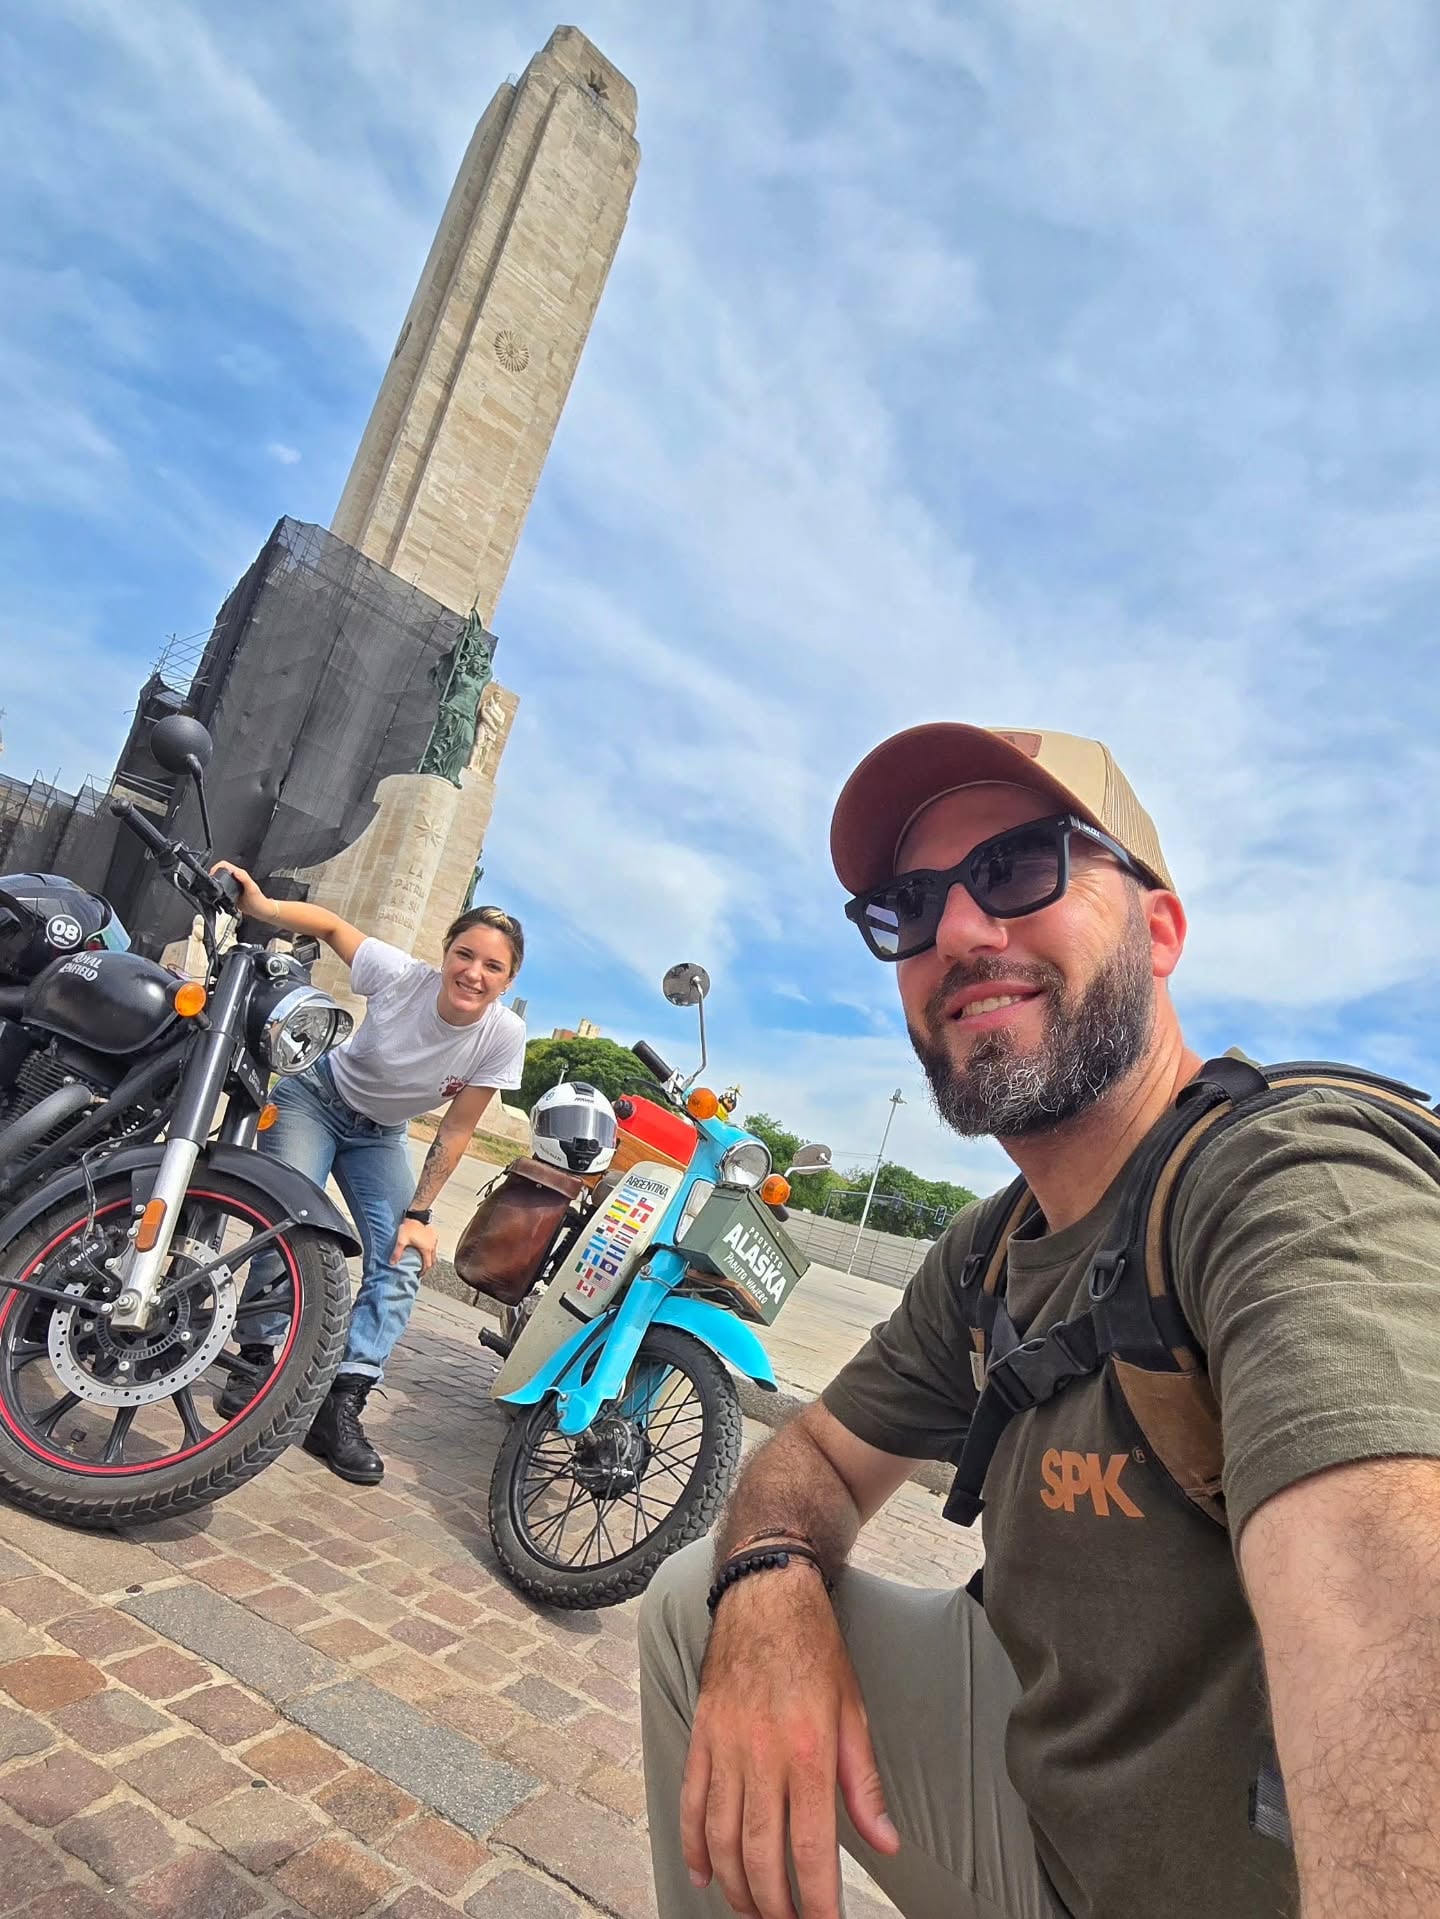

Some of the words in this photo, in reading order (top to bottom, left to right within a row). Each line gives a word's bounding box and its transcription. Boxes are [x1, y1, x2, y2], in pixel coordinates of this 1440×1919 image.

[407, 863, 423, 879] LA
[51, 919, 79, 940] 08
[72, 952, 103, 969] ROYAL
[625, 1175, 669, 1199] ARGENTINA
[748, 1226, 783, 1270] PROYECTO
[722, 1222, 787, 1305] ALASKA
[745, 1278, 769, 1305] VIAJERO
[1040, 1448, 1145, 1518] SPK
